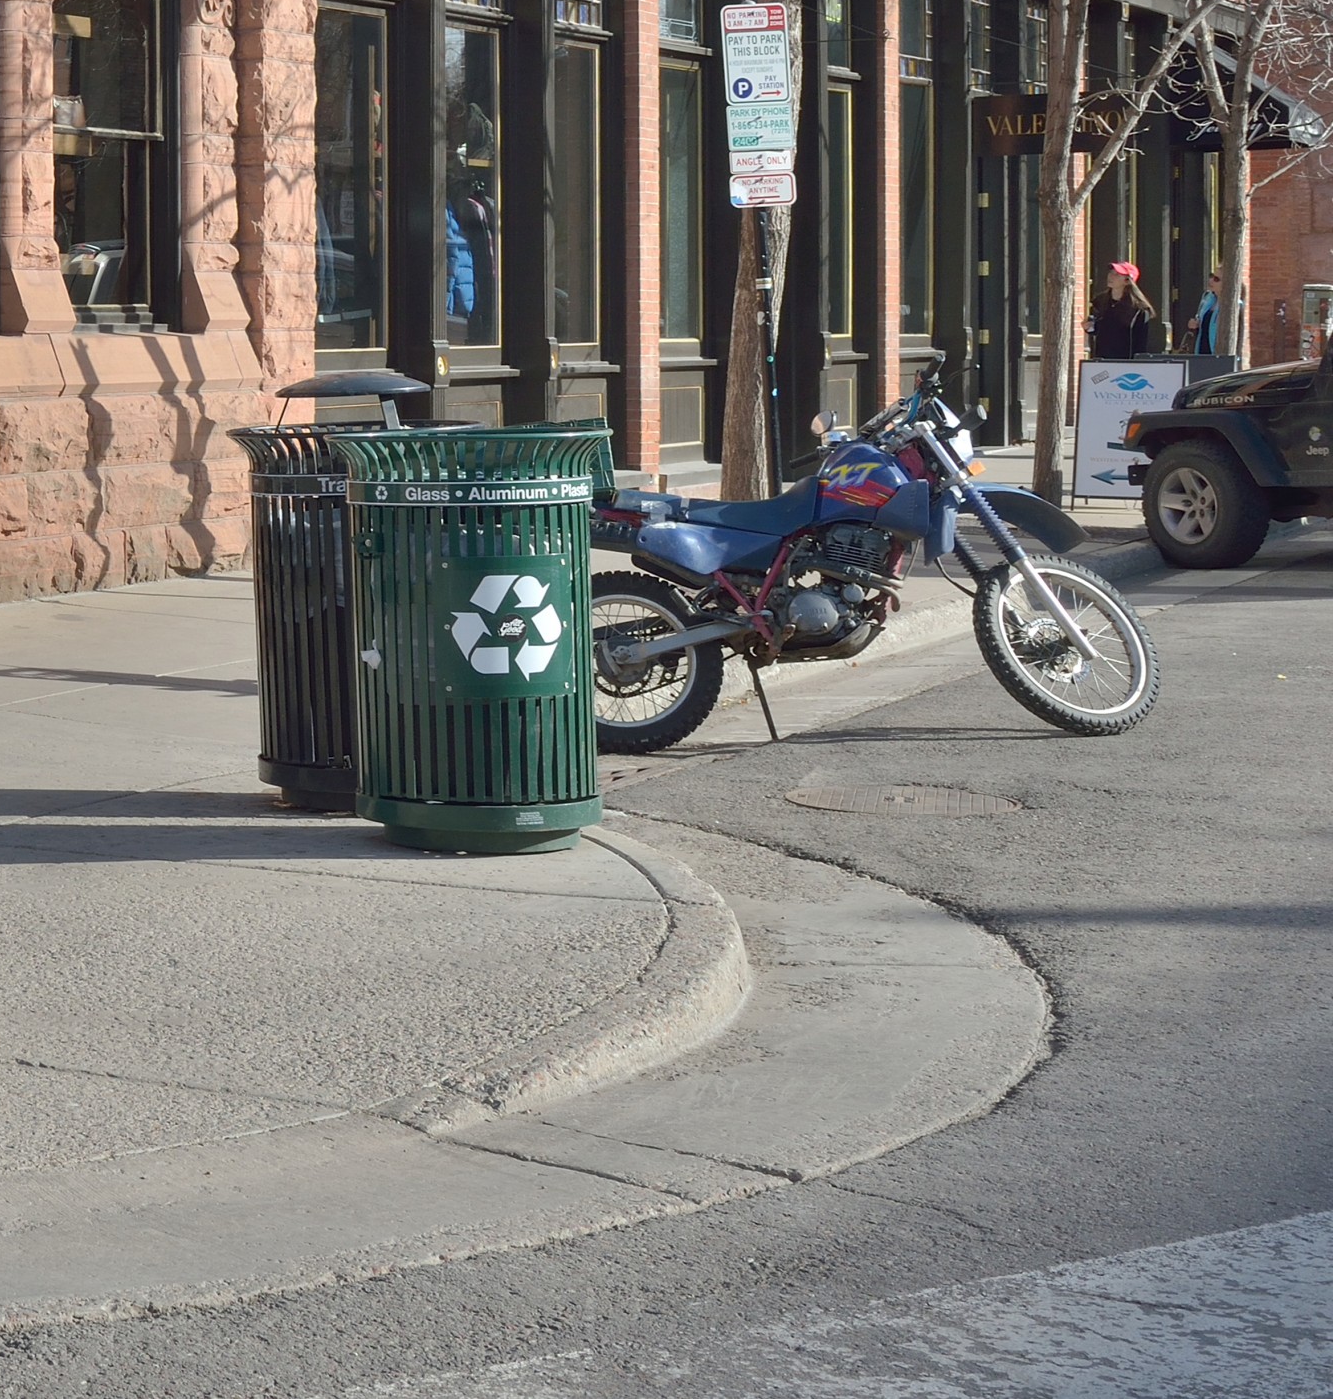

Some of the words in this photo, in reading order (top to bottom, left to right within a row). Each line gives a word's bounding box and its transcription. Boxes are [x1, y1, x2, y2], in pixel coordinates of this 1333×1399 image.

[738, 11, 767, 19] PARKING
[728, 36, 744, 45] PAY
[746, 35, 758, 45] TO
[760, 34, 783, 44] PARK
[732, 46, 751, 56] THIS
[753, 45, 780, 56] BLOCK
[738, 81, 749, 95] P
[758, 81, 785, 89] STATION
[730, 109, 750, 117] PARK
[751, 108, 761, 116] BY
[762, 107, 790, 116] PHONE
[985, 109, 1123, 136] VALEINO
[736, 157, 763, 166] ANGLE
[766, 156, 788, 165] ONLY
[748, 186, 779, 194] ANYTIME
[1093, 391, 1127, 399] WIND
[1131, 391, 1170, 400] RIVER
[1193, 394, 1255, 406] RUBICON
[1306, 445, 1330, 456] Jeep
[317, 477, 347, 493] Tra
[405, 486, 450, 501] Glass
[468, 486, 549, 501] Aluminum
[560, 483, 589, 498] Plastic
